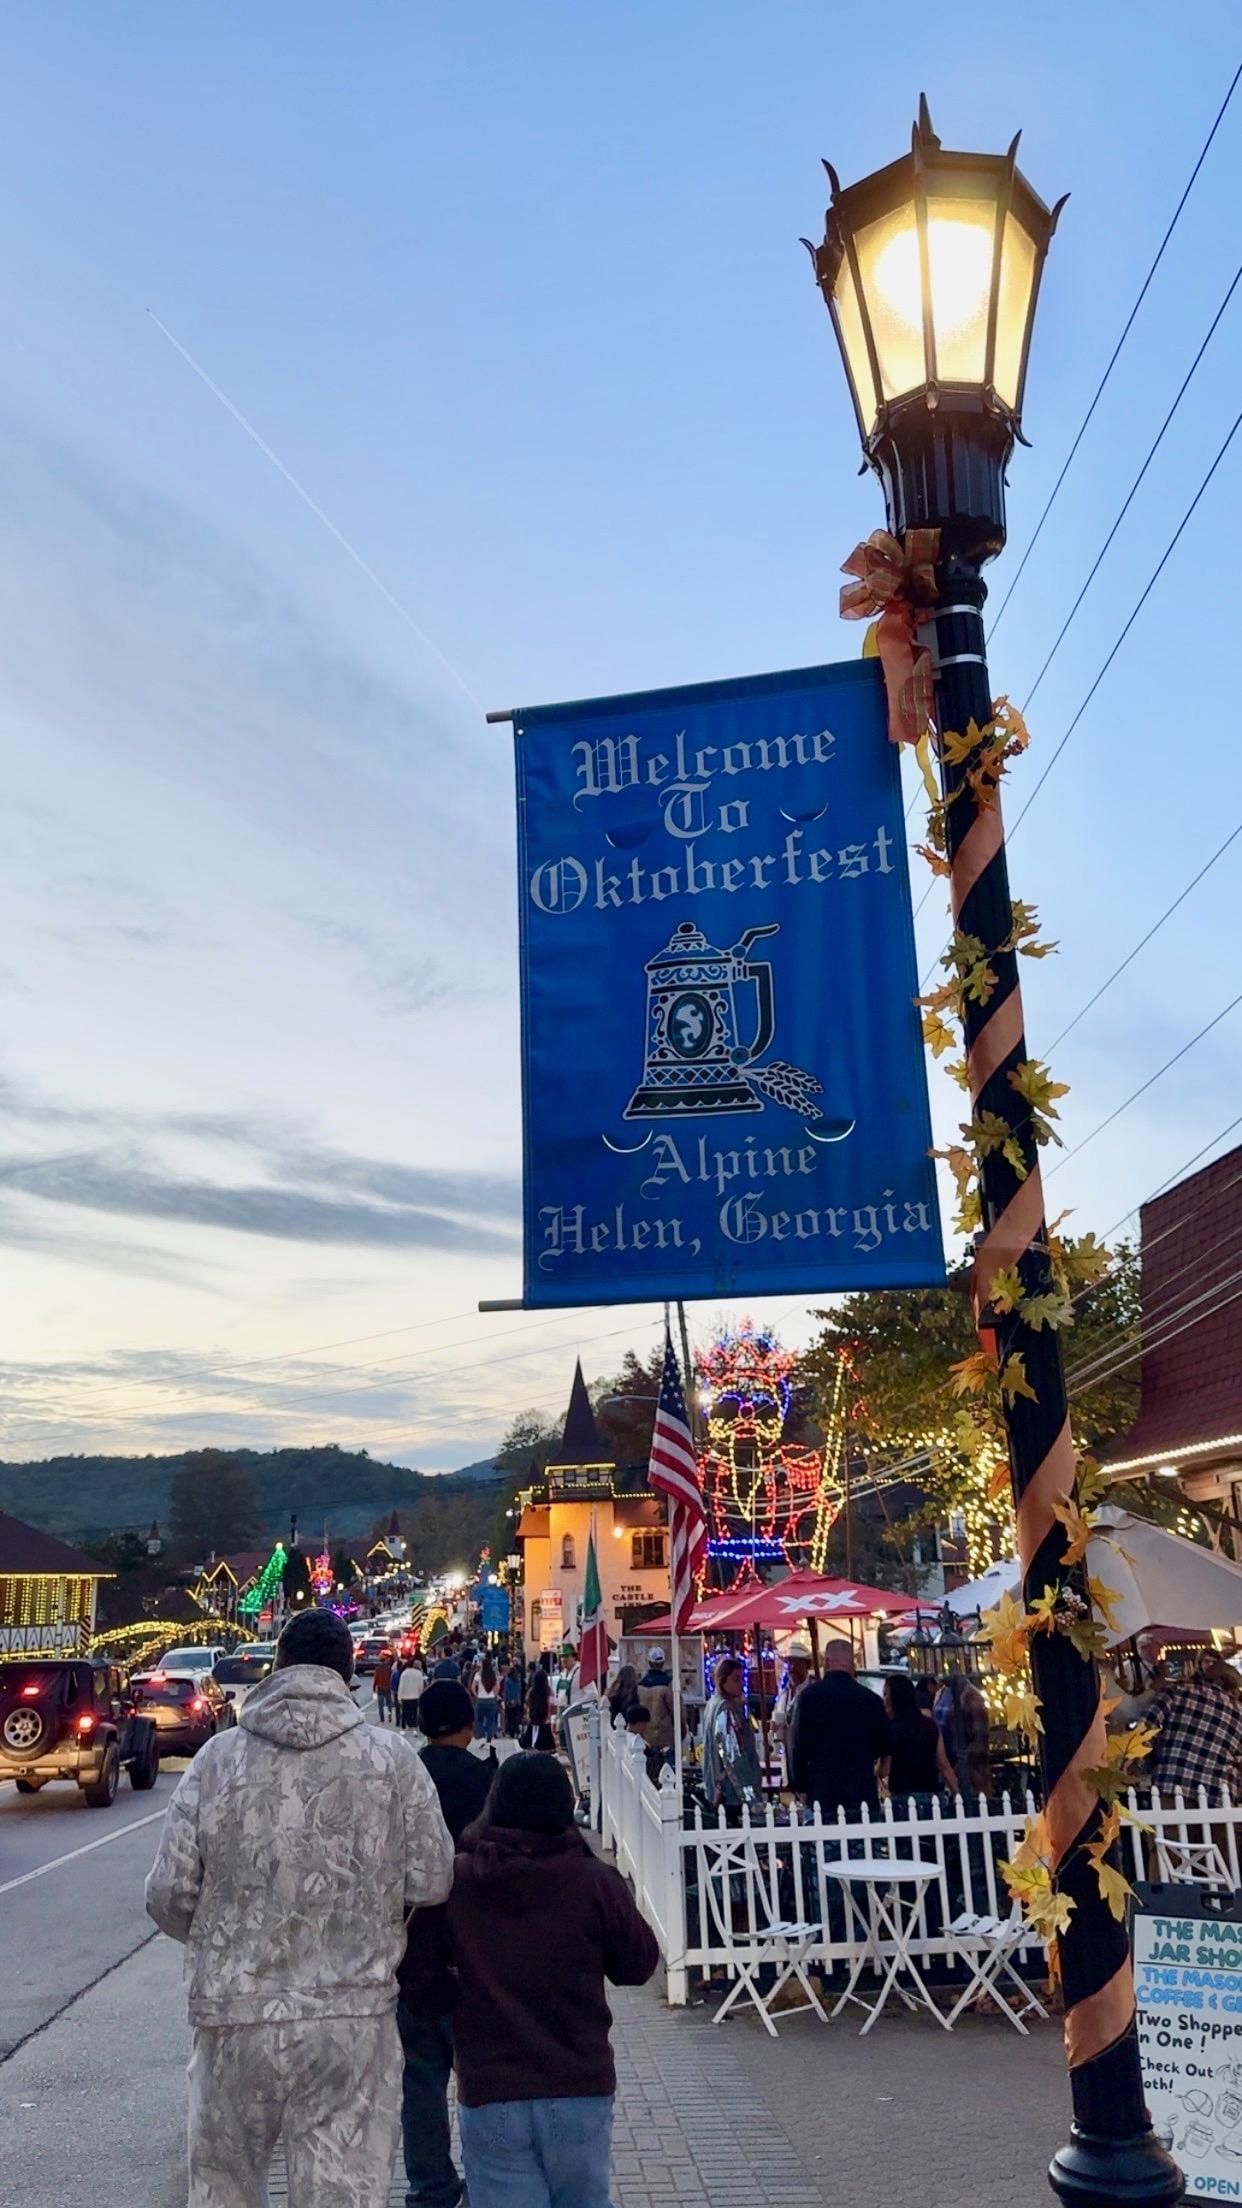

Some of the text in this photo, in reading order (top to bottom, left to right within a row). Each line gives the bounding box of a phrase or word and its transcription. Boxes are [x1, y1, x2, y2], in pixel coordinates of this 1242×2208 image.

[570, 728, 837, 813] Welcome
[658, 781, 750, 839] To
[531, 825, 895, 914] Oktoberfest
[640, 1134, 817, 1201] Alpine
[538, 1189, 932, 1271] Helen, Georgia
[612, 1593, 655, 1601] CASTLE
[1152, 1919, 1194, 1940] THE
[1148, 1941, 1242, 1968] JAR SHO
[1142, 1967, 1178, 1986] THE
[1136, 1985, 1204, 2009] COFFEE
[1136, 2009, 1172, 2028] Two
[1185, 2063, 1214, 2078] Out
[1143, 2077, 1174, 2094] oth!
[1194, 2176, 1240, 2196] OPEN
